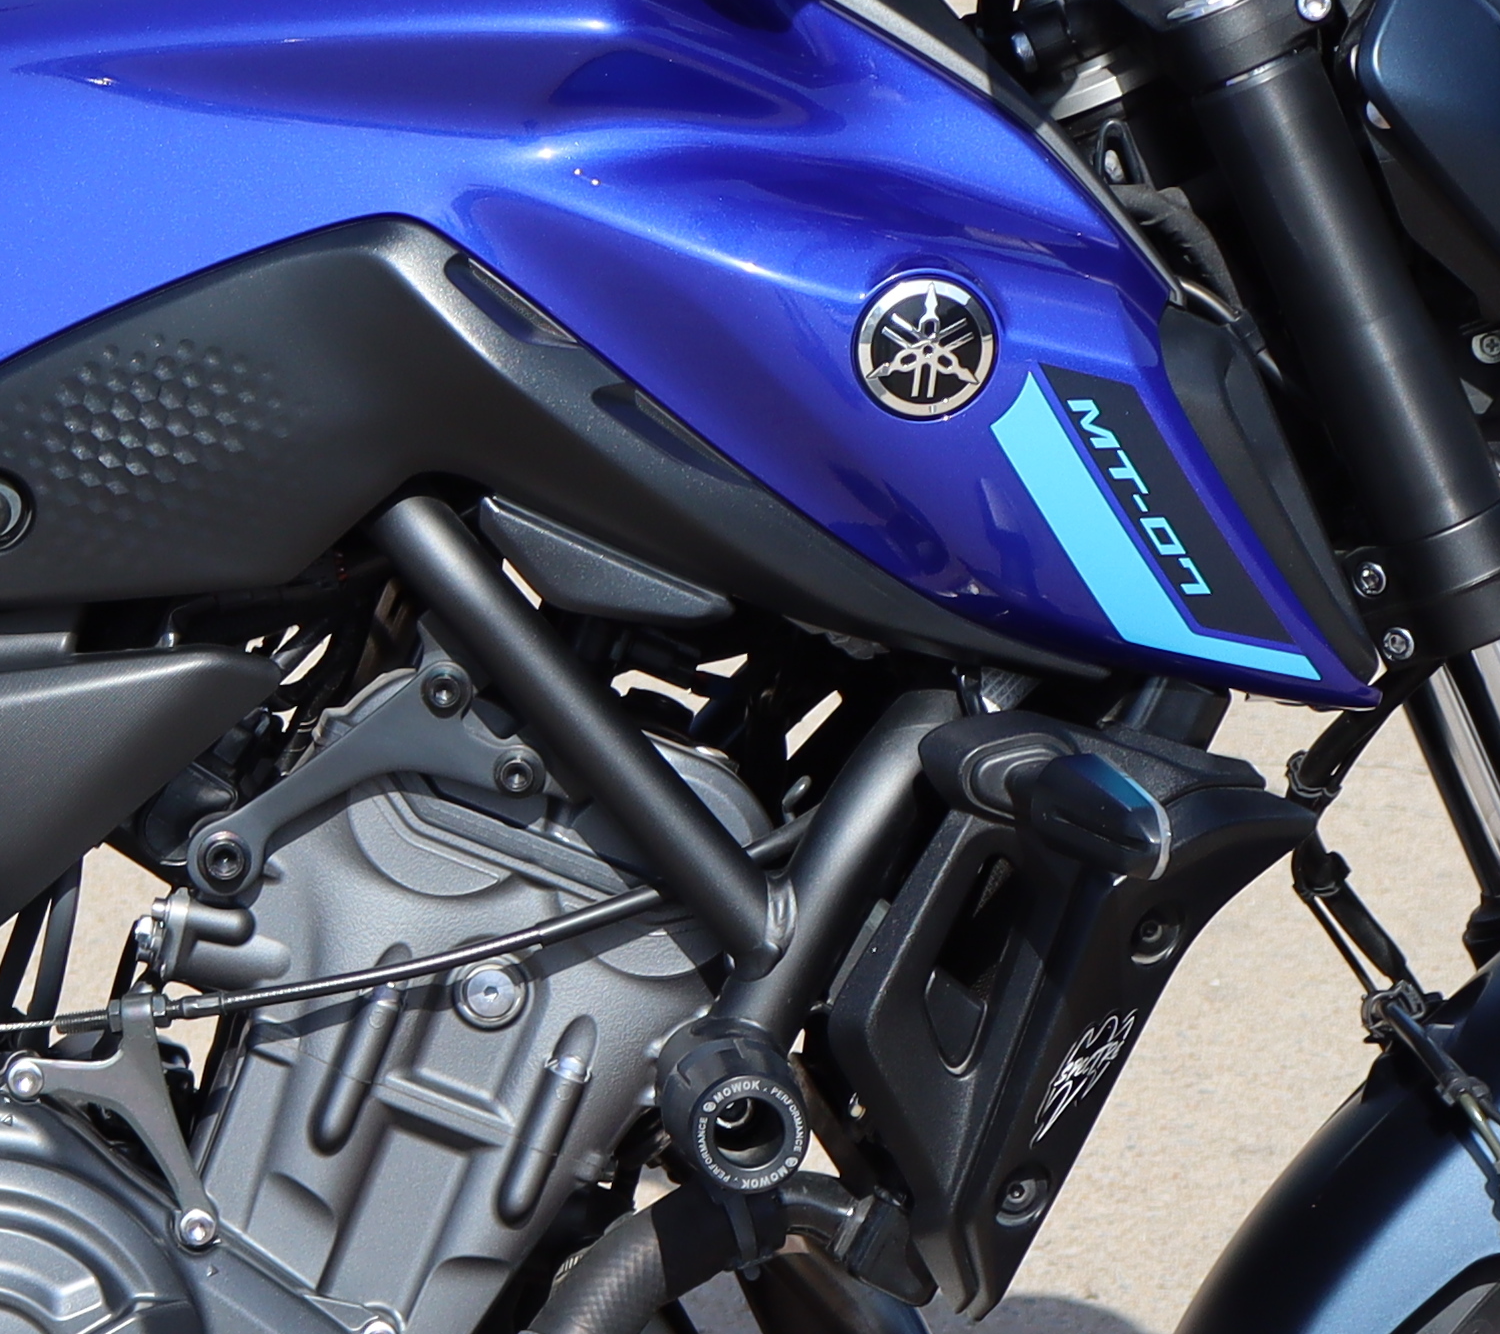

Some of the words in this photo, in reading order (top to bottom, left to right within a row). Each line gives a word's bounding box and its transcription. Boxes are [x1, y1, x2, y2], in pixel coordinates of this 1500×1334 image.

[1066, 399, 1212, 595] MT-07
[697, 1117, 731, 1182] PERFORMANCE
[713, 1080, 760, 1104] MOWOK
[770, 1086, 804, 1152] PERFORMANCE
[741, 1165, 789, 1189] MOWOK
